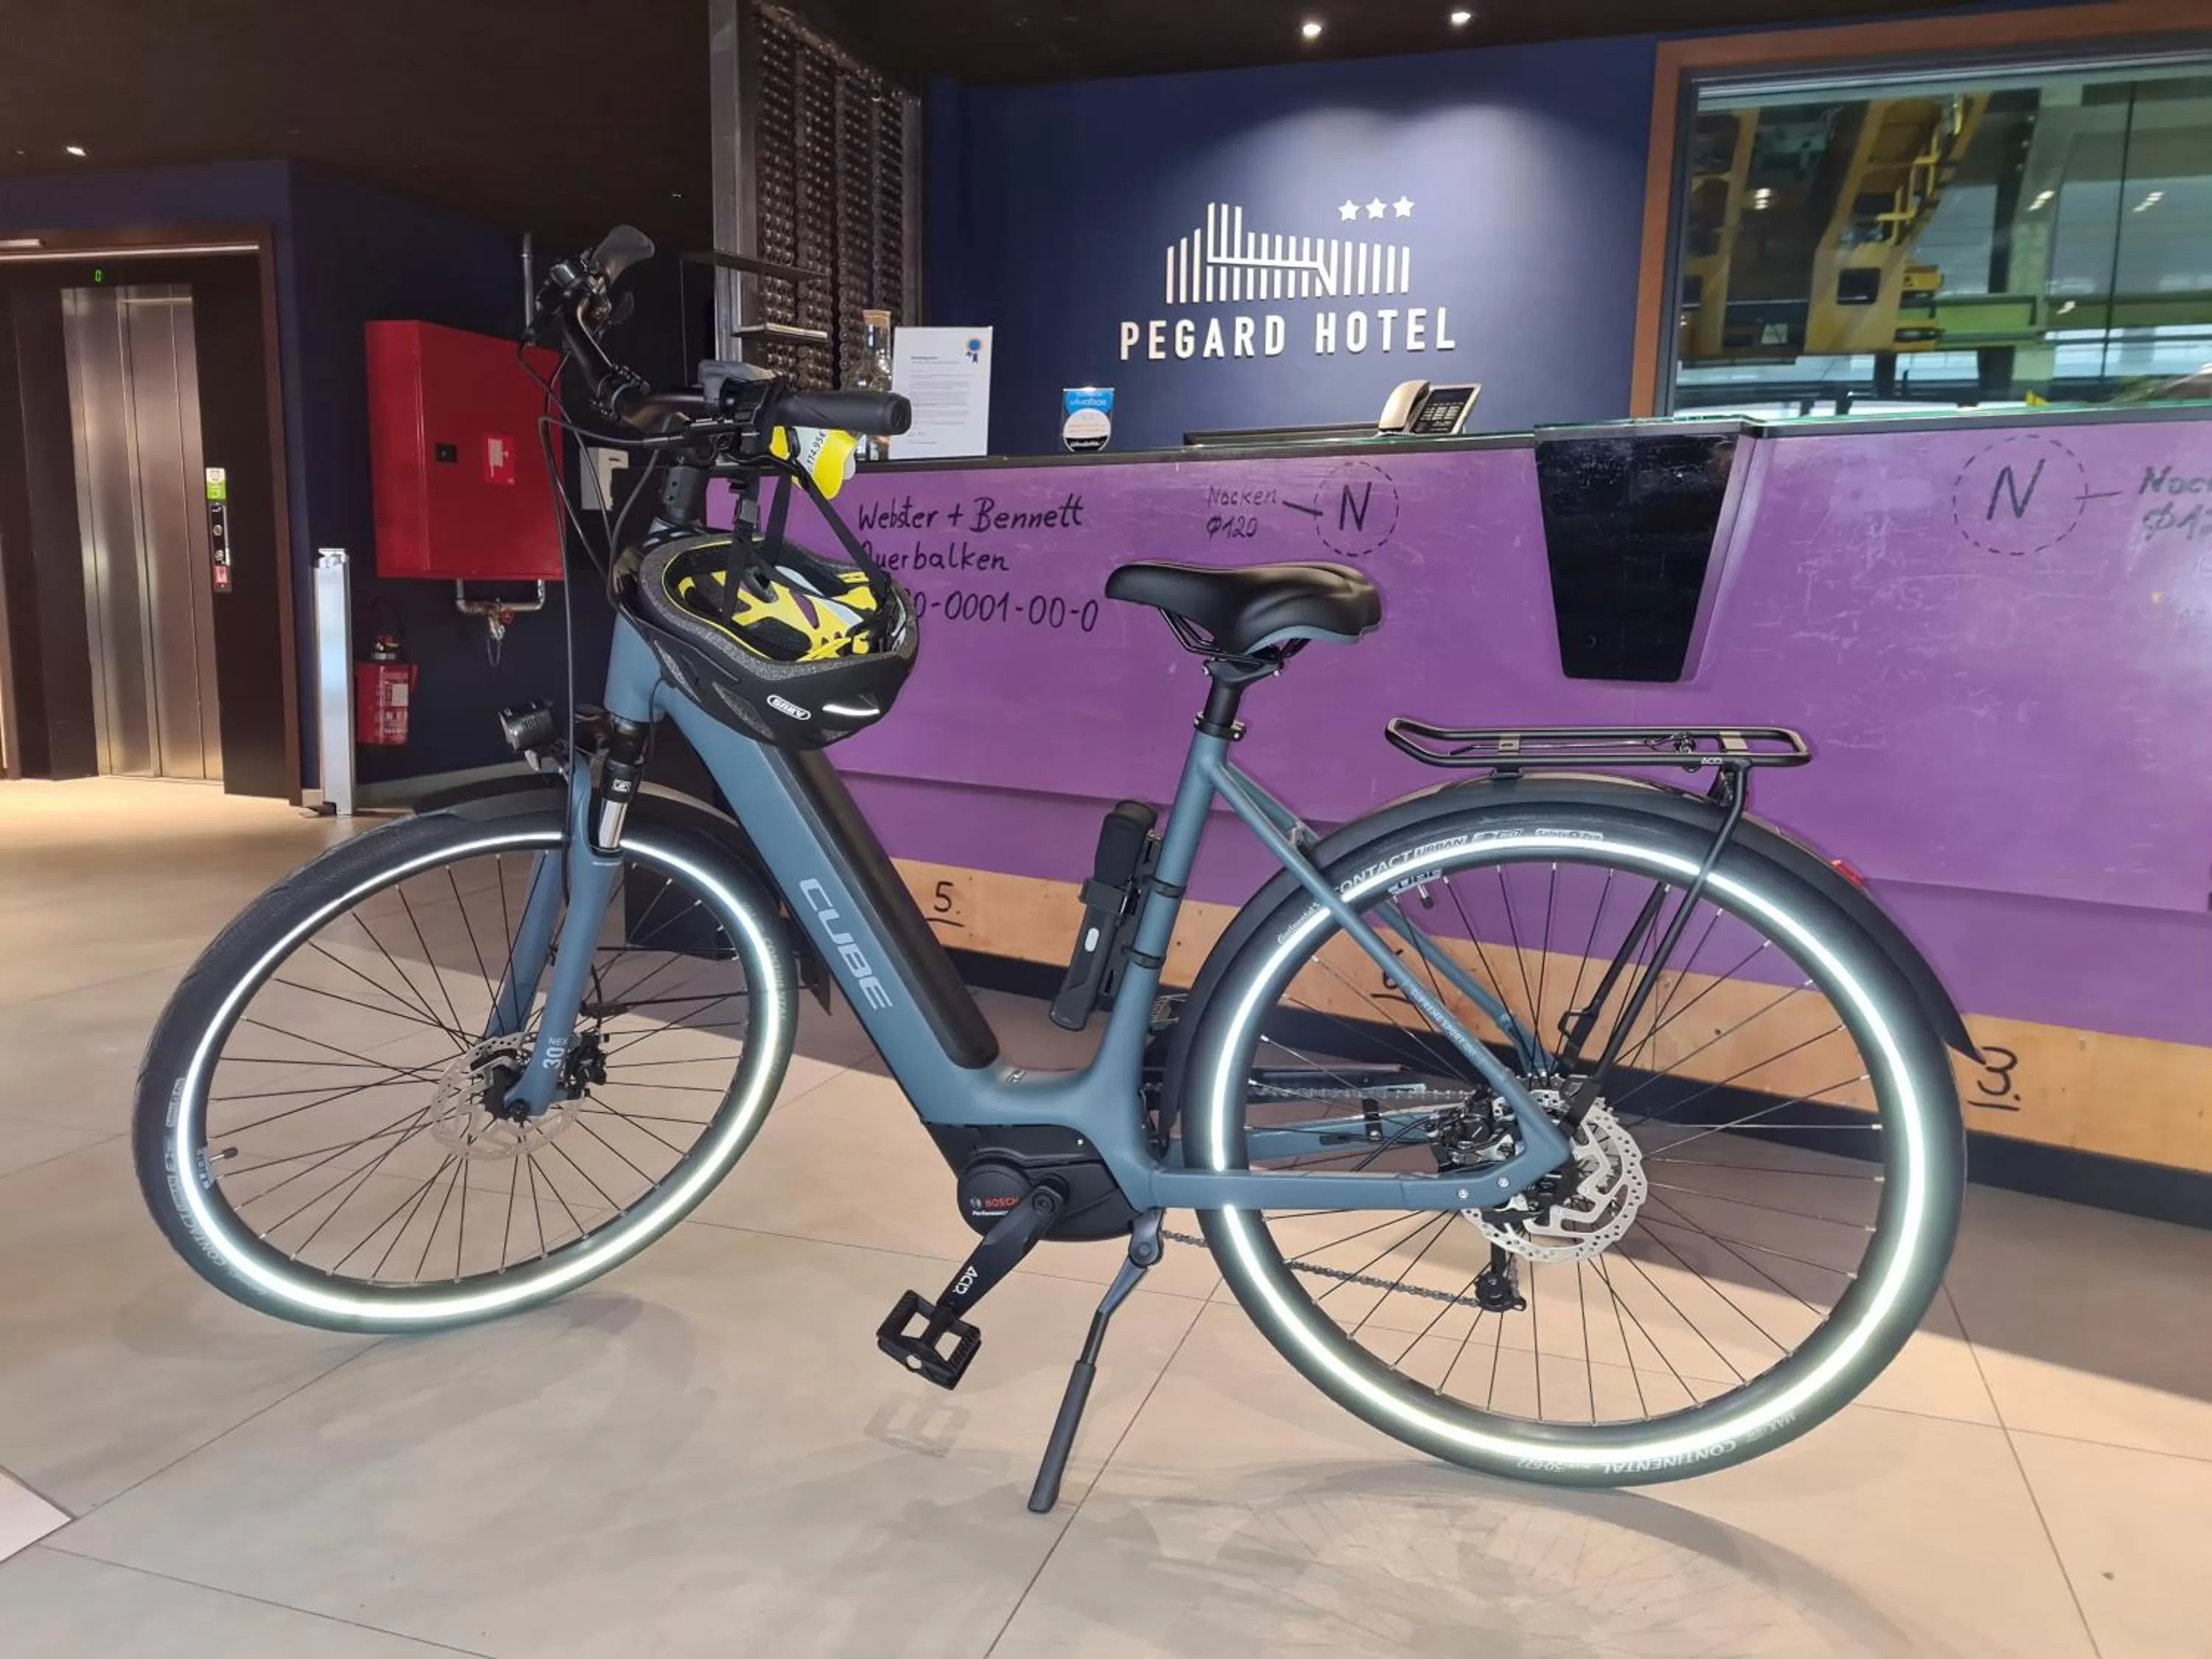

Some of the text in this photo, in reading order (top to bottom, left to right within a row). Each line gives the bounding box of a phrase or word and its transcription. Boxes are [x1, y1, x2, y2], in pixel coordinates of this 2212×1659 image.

[1120, 307, 1456, 361] PEGARD HOTEL
[1207, 485, 1277, 508] Nocken
[1338, 481, 1373, 532] N
[1986, 458, 2046, 520] N
[858, 495, 939, 530] Webster
[969, 493, 1084, 533] Bennett
[905, 588, 1099, 633] 0-0001-00-0
[1334, 850, 1413, 894] ONTACT
[799, 878, 894, 1011] CUBE
[542, 1047, 566, 1068] 30
[953, 1265, 978, 1295] ACID
[1603, 1439, 1737, 1475] CONTINENTAL
